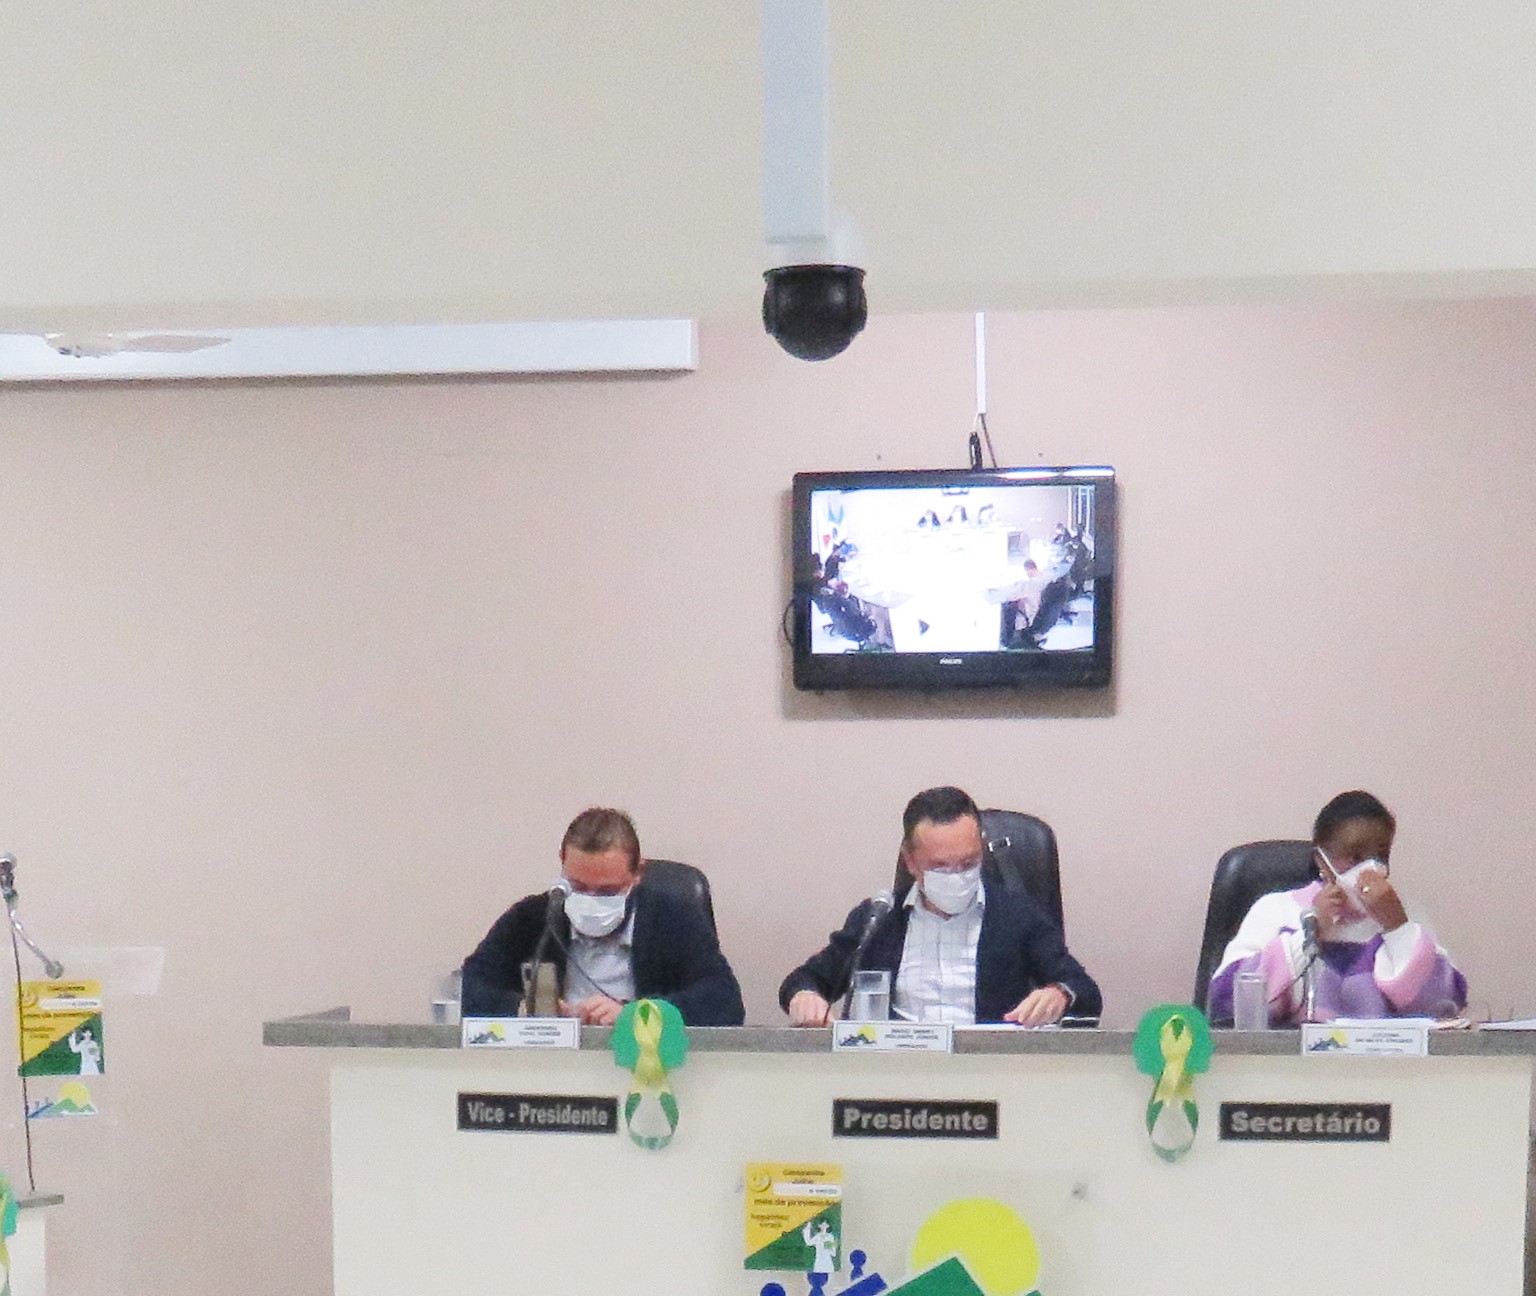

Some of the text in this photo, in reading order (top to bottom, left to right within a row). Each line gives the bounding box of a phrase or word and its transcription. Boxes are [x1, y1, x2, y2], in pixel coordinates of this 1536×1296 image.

[467, 1101, 505, 1123] Vice
[519, 1102, 609, 1126] Presidente
[843, 1107, 989, 1131] Presidente
[1230, 1110, 1381, 1134] Secretário
